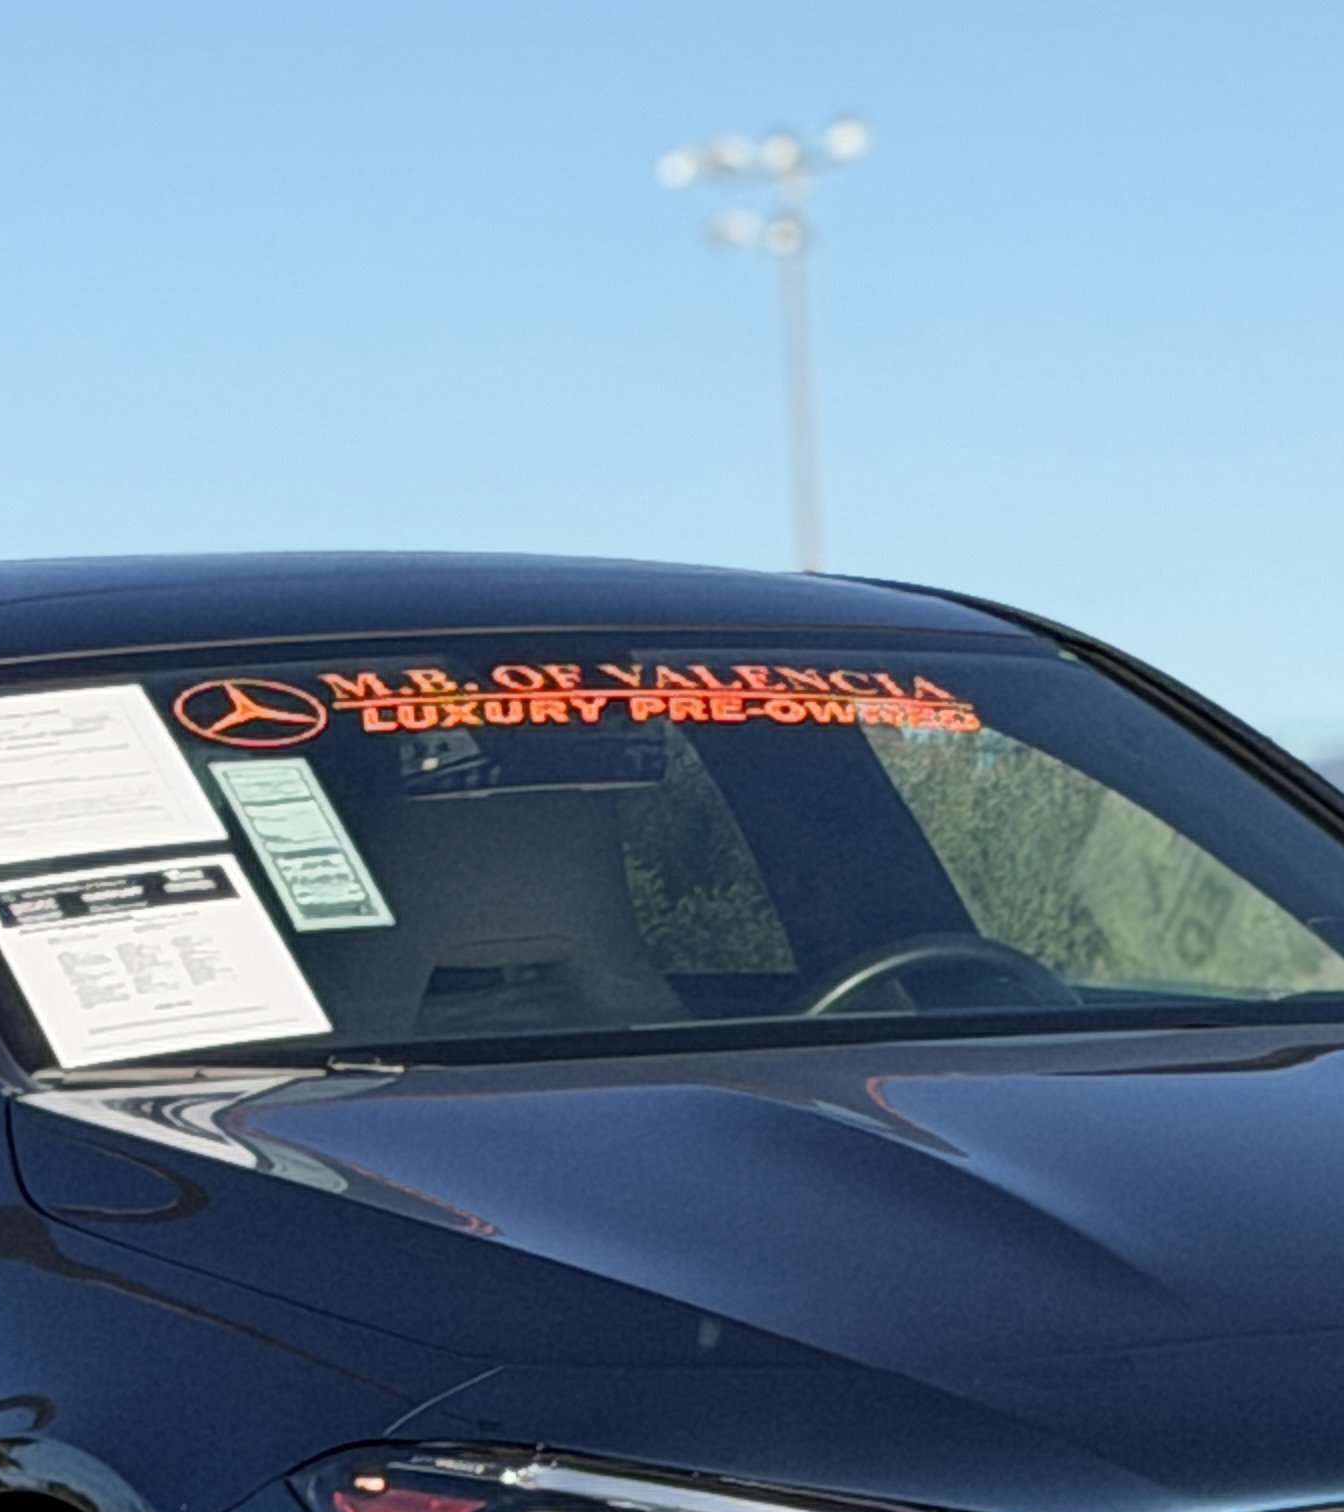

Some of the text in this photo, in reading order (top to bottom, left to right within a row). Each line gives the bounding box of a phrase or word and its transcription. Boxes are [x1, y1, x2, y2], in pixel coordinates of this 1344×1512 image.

[317, 663, 956, 700] M.B. OF VALENCIA
[362, 696, 981, 732] LUXURY PRE-OWNED
